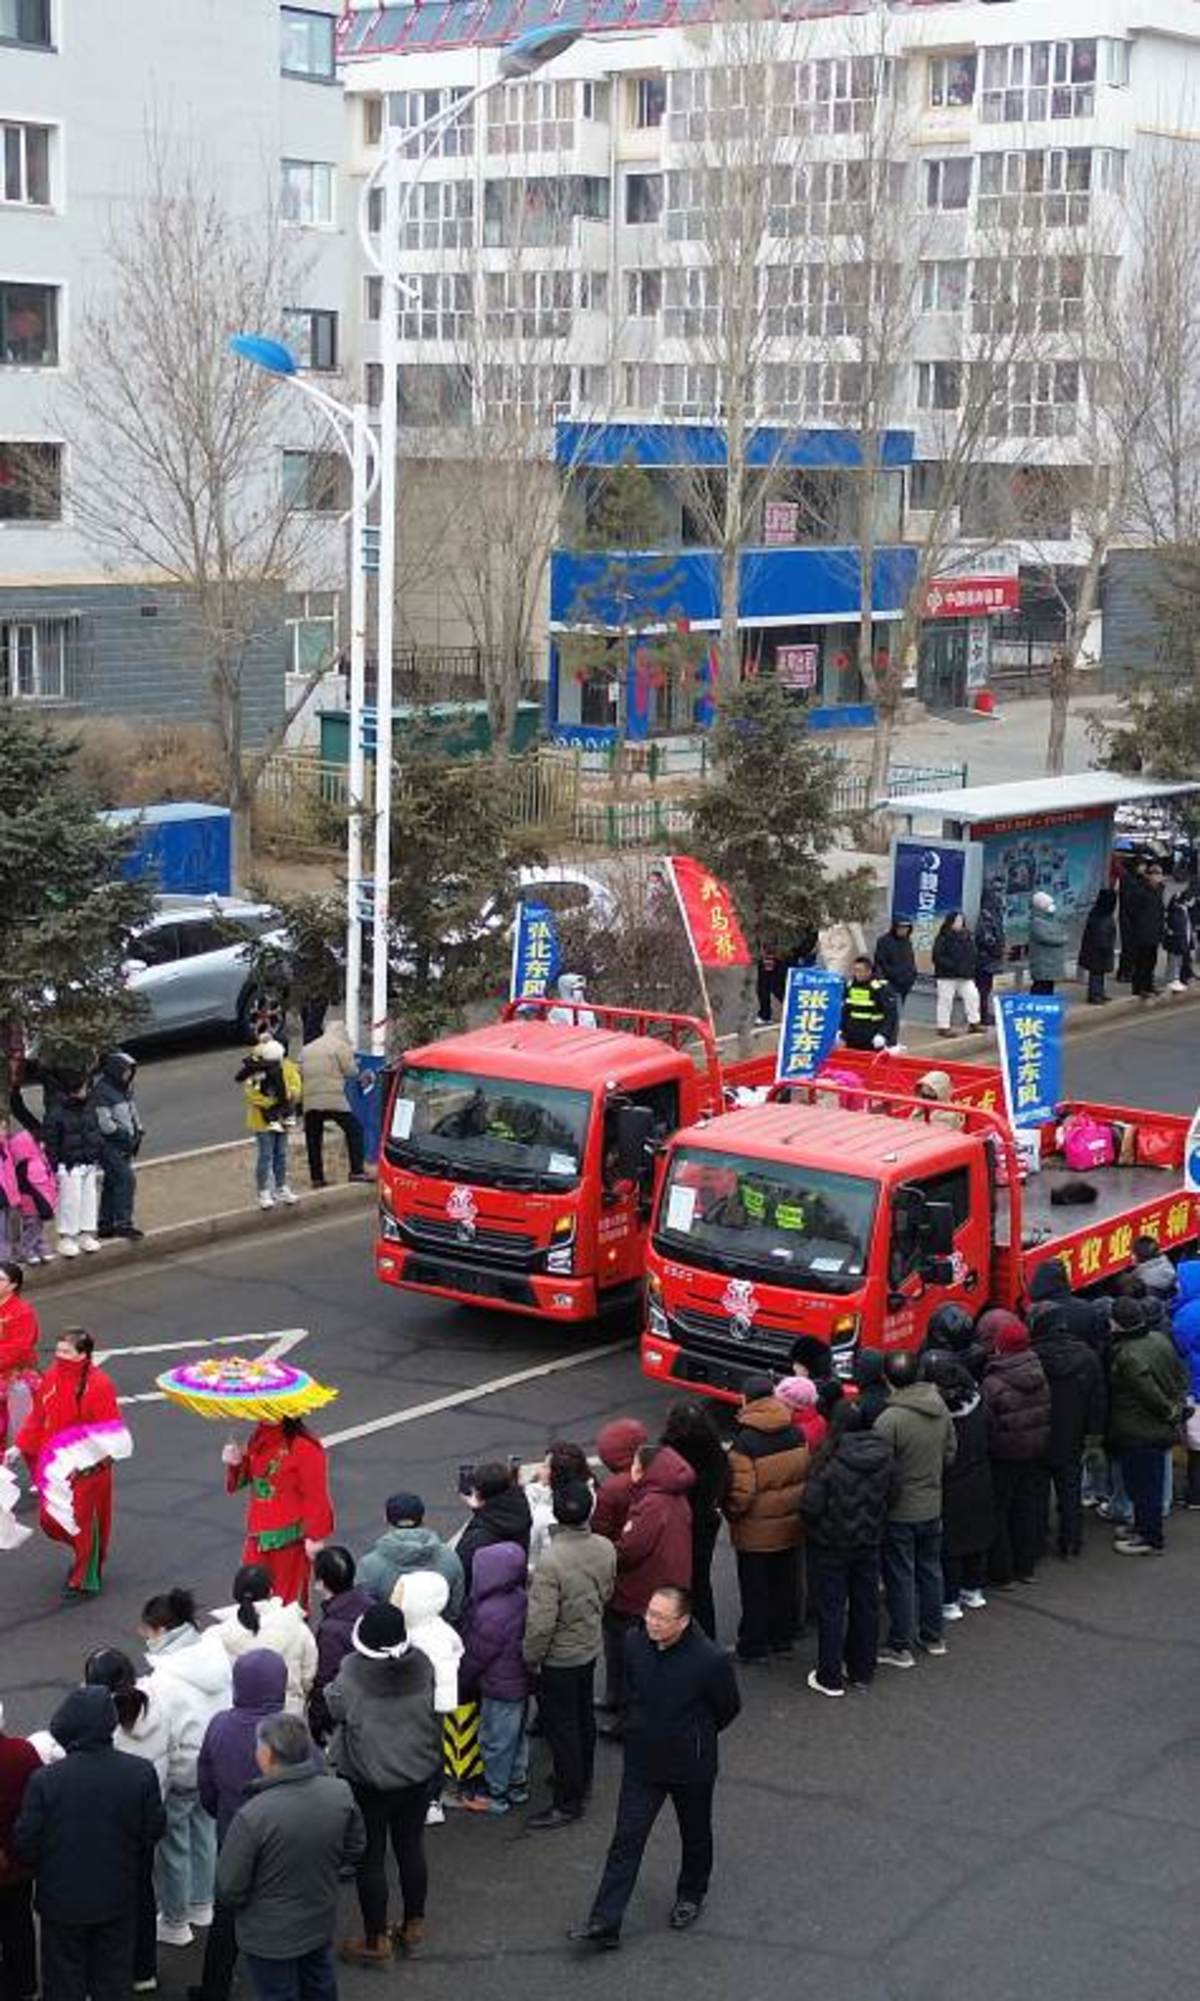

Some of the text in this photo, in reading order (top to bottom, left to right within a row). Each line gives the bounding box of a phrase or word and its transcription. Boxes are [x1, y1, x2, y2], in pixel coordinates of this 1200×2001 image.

[787, 989, 829, 1072] 张北东风
[1015, 1017, 1045, 1107] 张北东风
